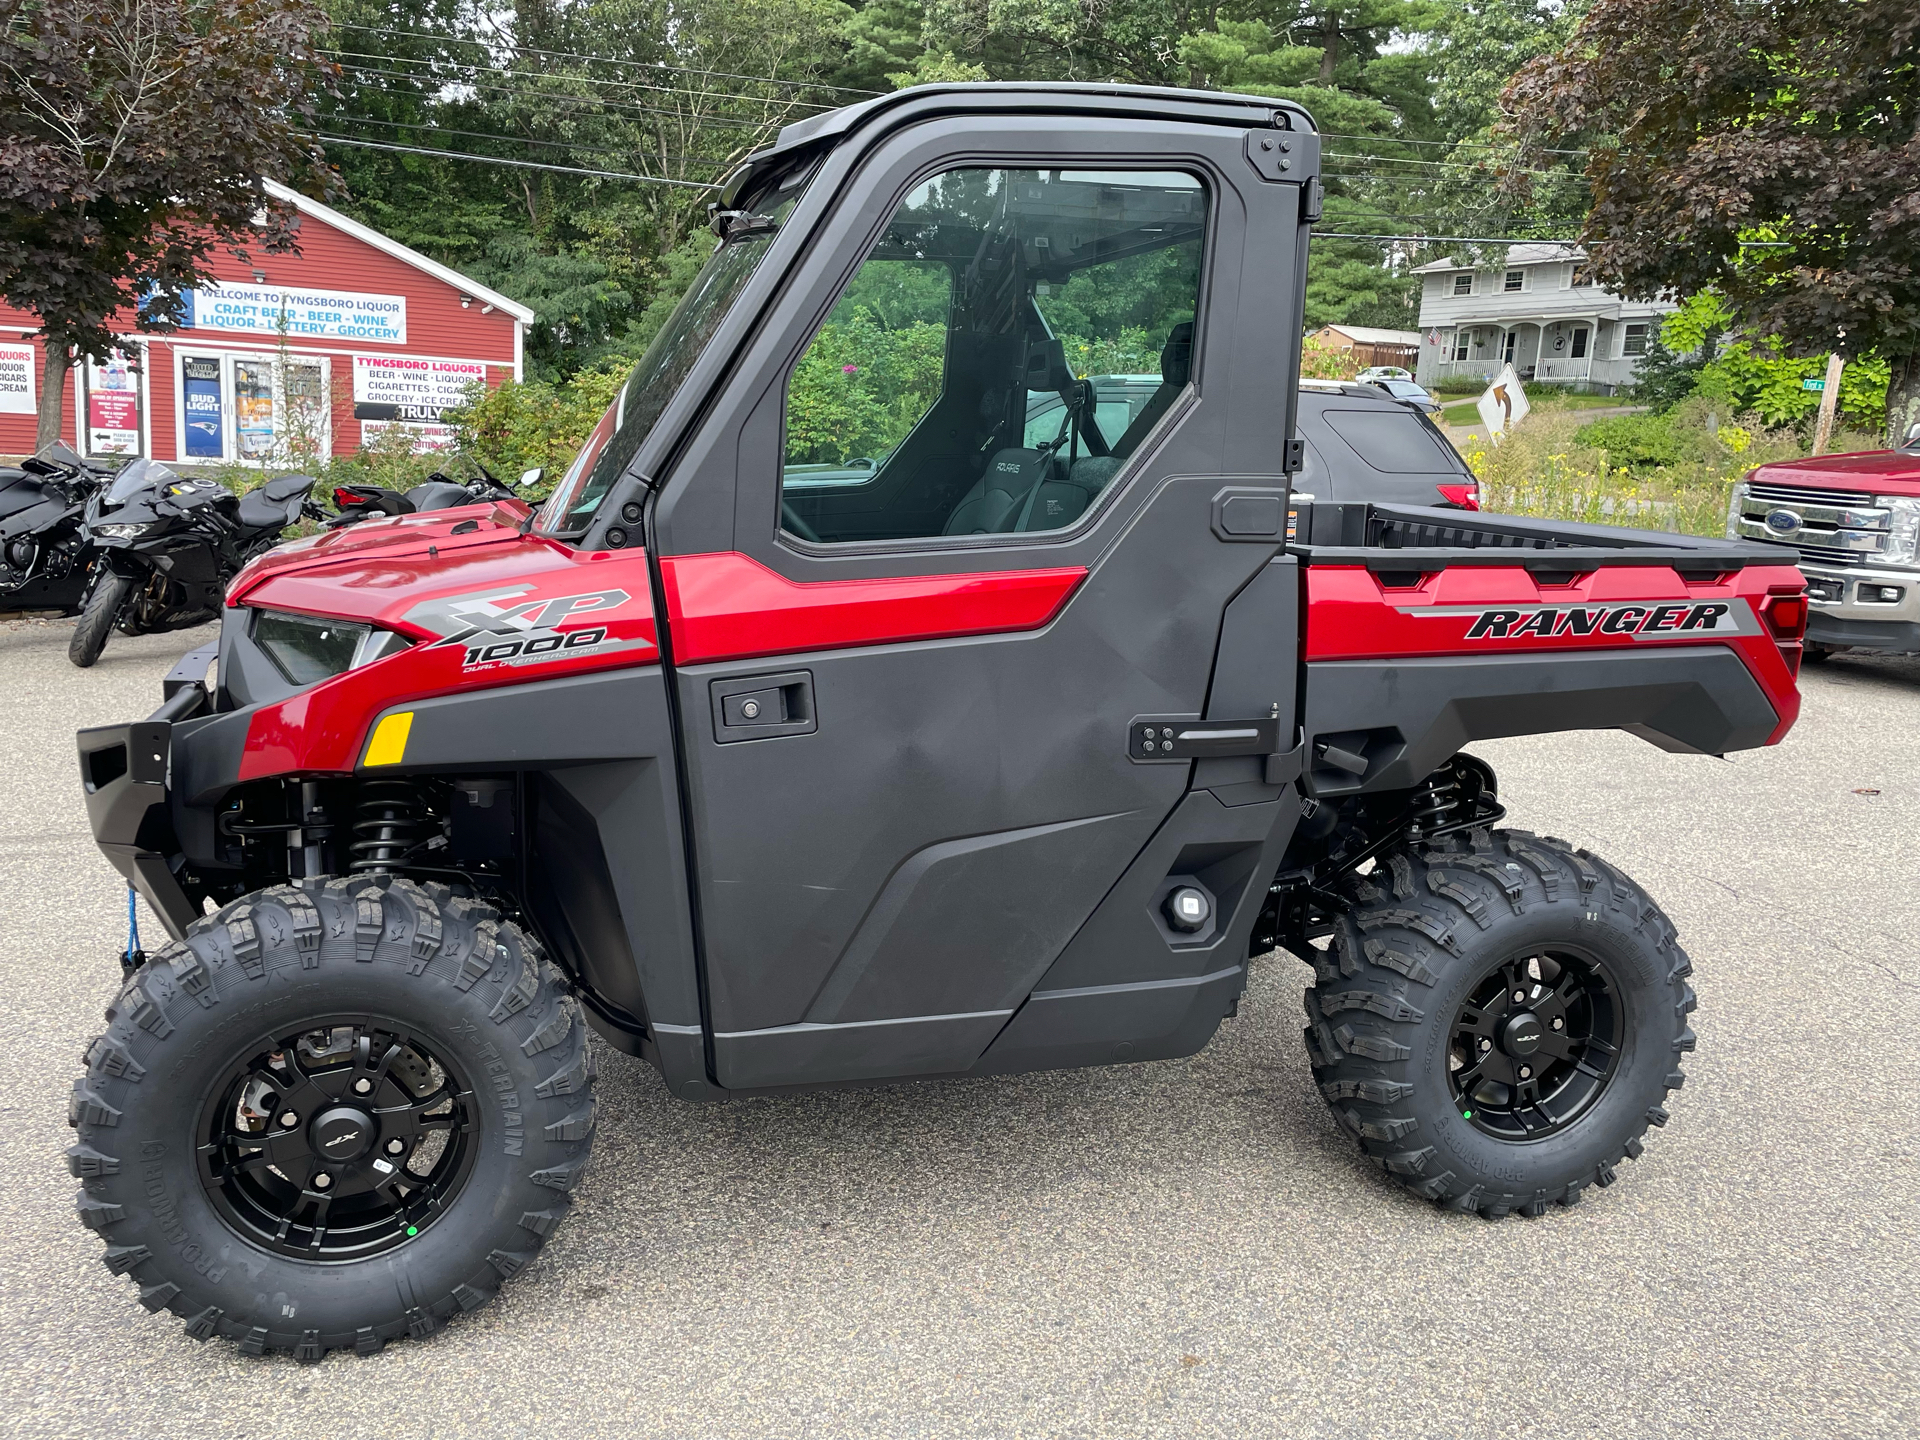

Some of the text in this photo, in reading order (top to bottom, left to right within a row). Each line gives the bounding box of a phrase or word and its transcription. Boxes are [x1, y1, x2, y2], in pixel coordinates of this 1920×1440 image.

[201, 288, 400, 314] WELCOME TO YNGSBORO LIQUOR
[202, 314, 400, 339] LIQUOR LTTERY GROCERY
[214, 303, 258, 316] CRAFT
[307, 311, 342, 323] BEER
[353, 314, 388, 327] WINE
[357, 357, 482, 374] TYNGSBORO LIQUORS
[369, 370, 395, 379] BEER
[402, 372, 429, 381] WINE
[190, 394, 216, 403] BUD
[367, 393, 415, 403] GROCERY
[421, 396, 437, 405] ICE
[368, 381, 430, 393] CIGARETTES
[186, 401, 220, 412] LIGHT
[399, 405, 443, 419] TRULY
[1771, 516, 1791, 528] Ford
[418, 588, 632, 651] XP
[1464, 602, 1730, 639] RANGER
[462, 626, 608, 667] 1000
[463, 646, 599, 674] DUAL OVERHEAD CAM
[449, 1017, 526, 1158] X-TERRAIN
[1443, 1131, 1527, 1183] PRO ARMOR
[144, 1162, 231, 1285] PRO ARMOR
[281, 1304, 296, 1319] MB
